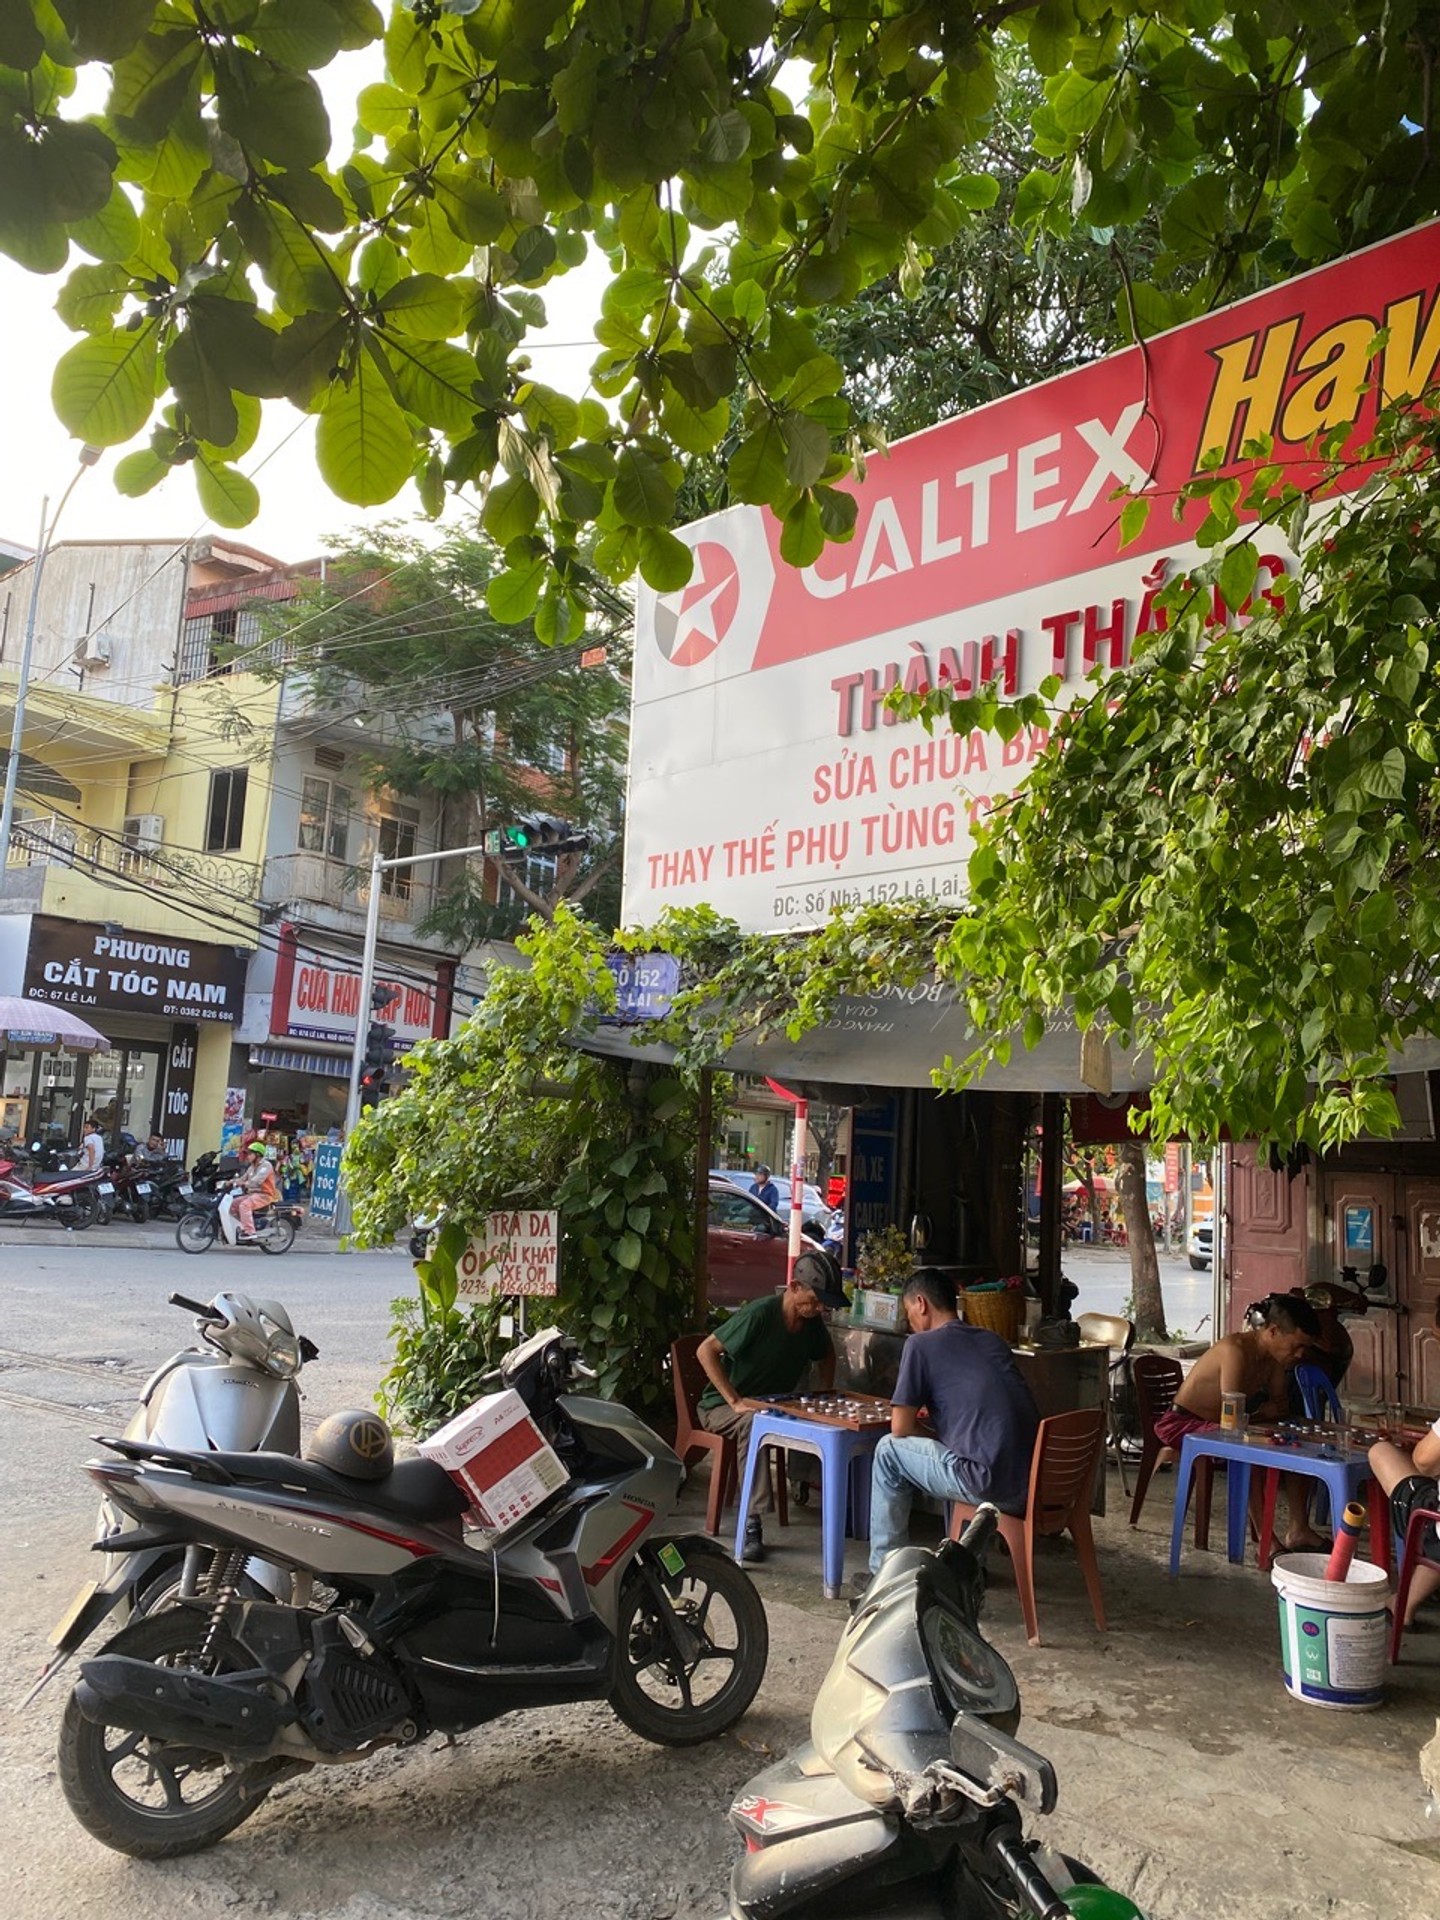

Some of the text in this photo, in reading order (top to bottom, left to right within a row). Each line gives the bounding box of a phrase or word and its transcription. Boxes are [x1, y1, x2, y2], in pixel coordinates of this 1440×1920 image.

[831, 628, 1021, 736] THÀNH
[813, 748, 877, 805] SỬA
[649, 844, 715, 889] THAY
[723, 819, 780, 877] THẾ
[785, 821, 849, 870] PHỤ
[861, 803, 955, 857] TÙNG
[773, 896, 800, 917] ĐC:
[805, 888, 827, 913] Số
[830, 887, 861, 910] Nhà
[867, 882, 898, 907] 152
[94, 936, 190, 969] PHƯƠNG
[44, 958, 226, 1004] CẮT TÓC NAM
[634, 969, 660, 987] 152
[28, 987, 97, 1004] ĐC: 67 LÊ LAI
[627, 993, 651, 1007] LAI
[173, 1038, 193, 1069] CẮT
[168, 1089, 188, 1115] TÓC
[320, 1149, 338, 1168] CẮT
[317, 1174, 334, 1190] TÓC
[313, 1195, 333, 1211] NAM
[504, 1264, 522, 1282] XE
